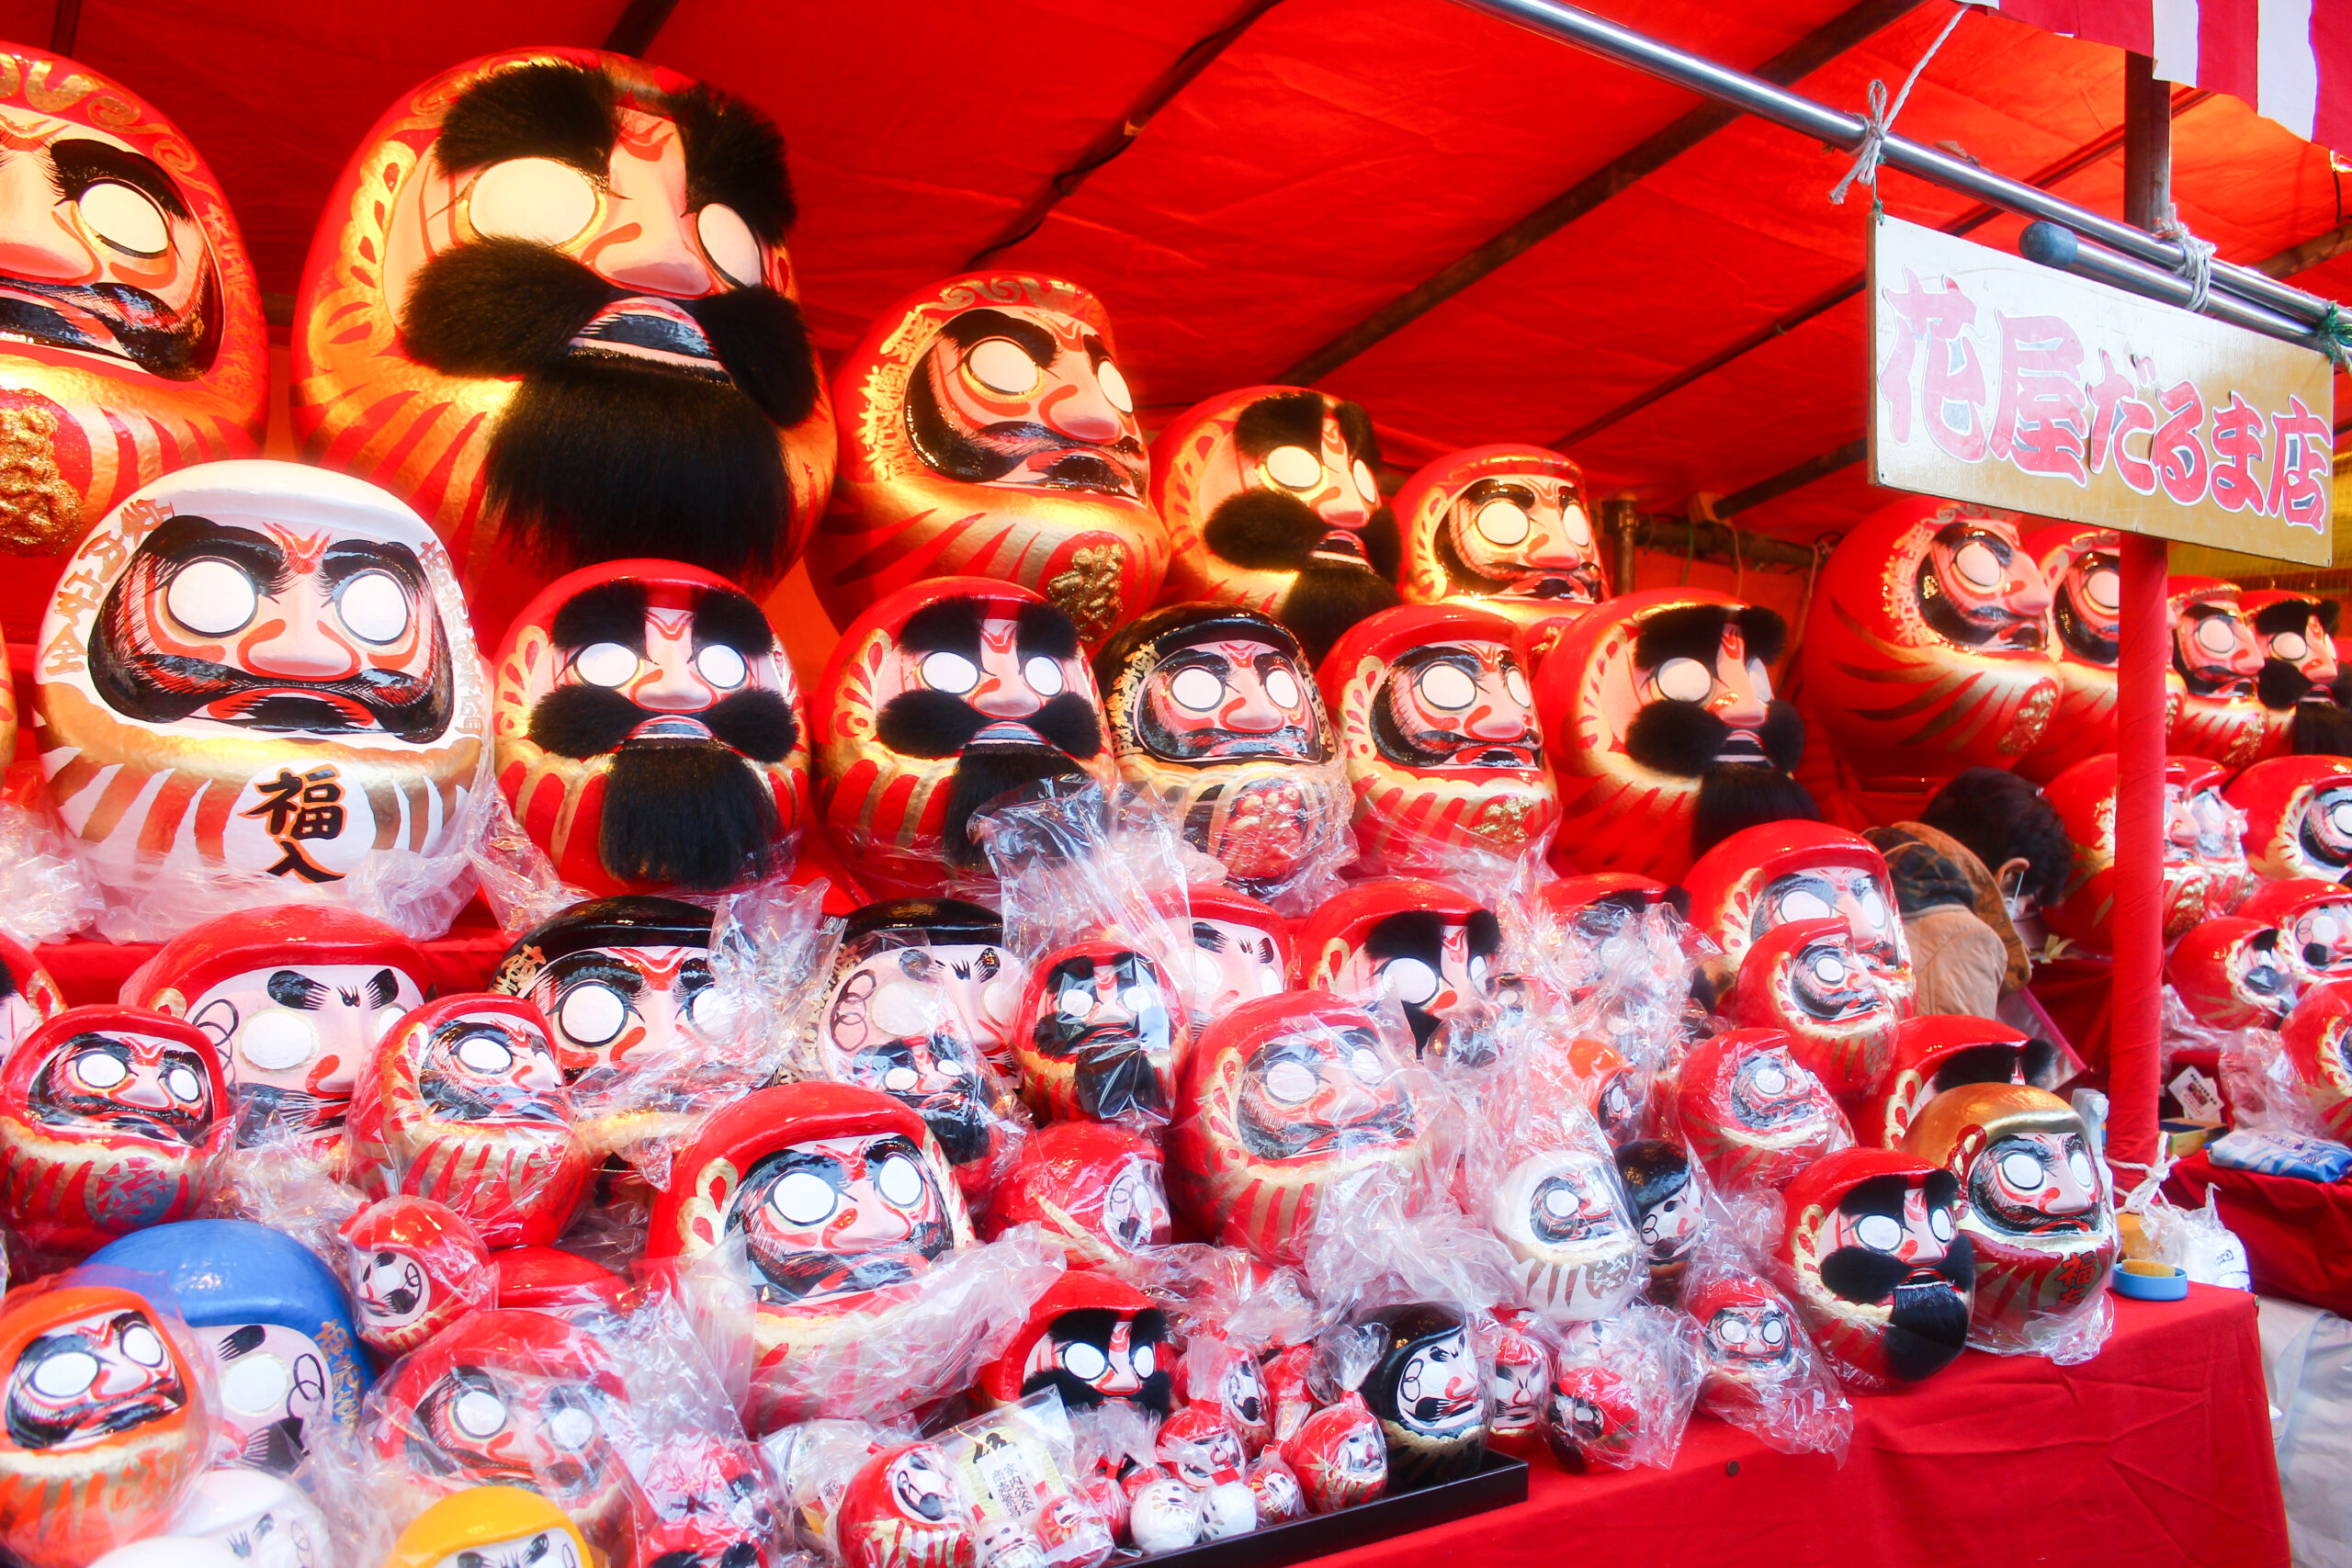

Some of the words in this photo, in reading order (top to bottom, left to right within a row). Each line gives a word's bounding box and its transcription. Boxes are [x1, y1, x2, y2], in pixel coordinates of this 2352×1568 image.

[1877, 265, 2333, 536] 花屋だるま店
[239, 762, 347, 884] 福入
[1003, 1463, 1035, 1515] 家内安全
